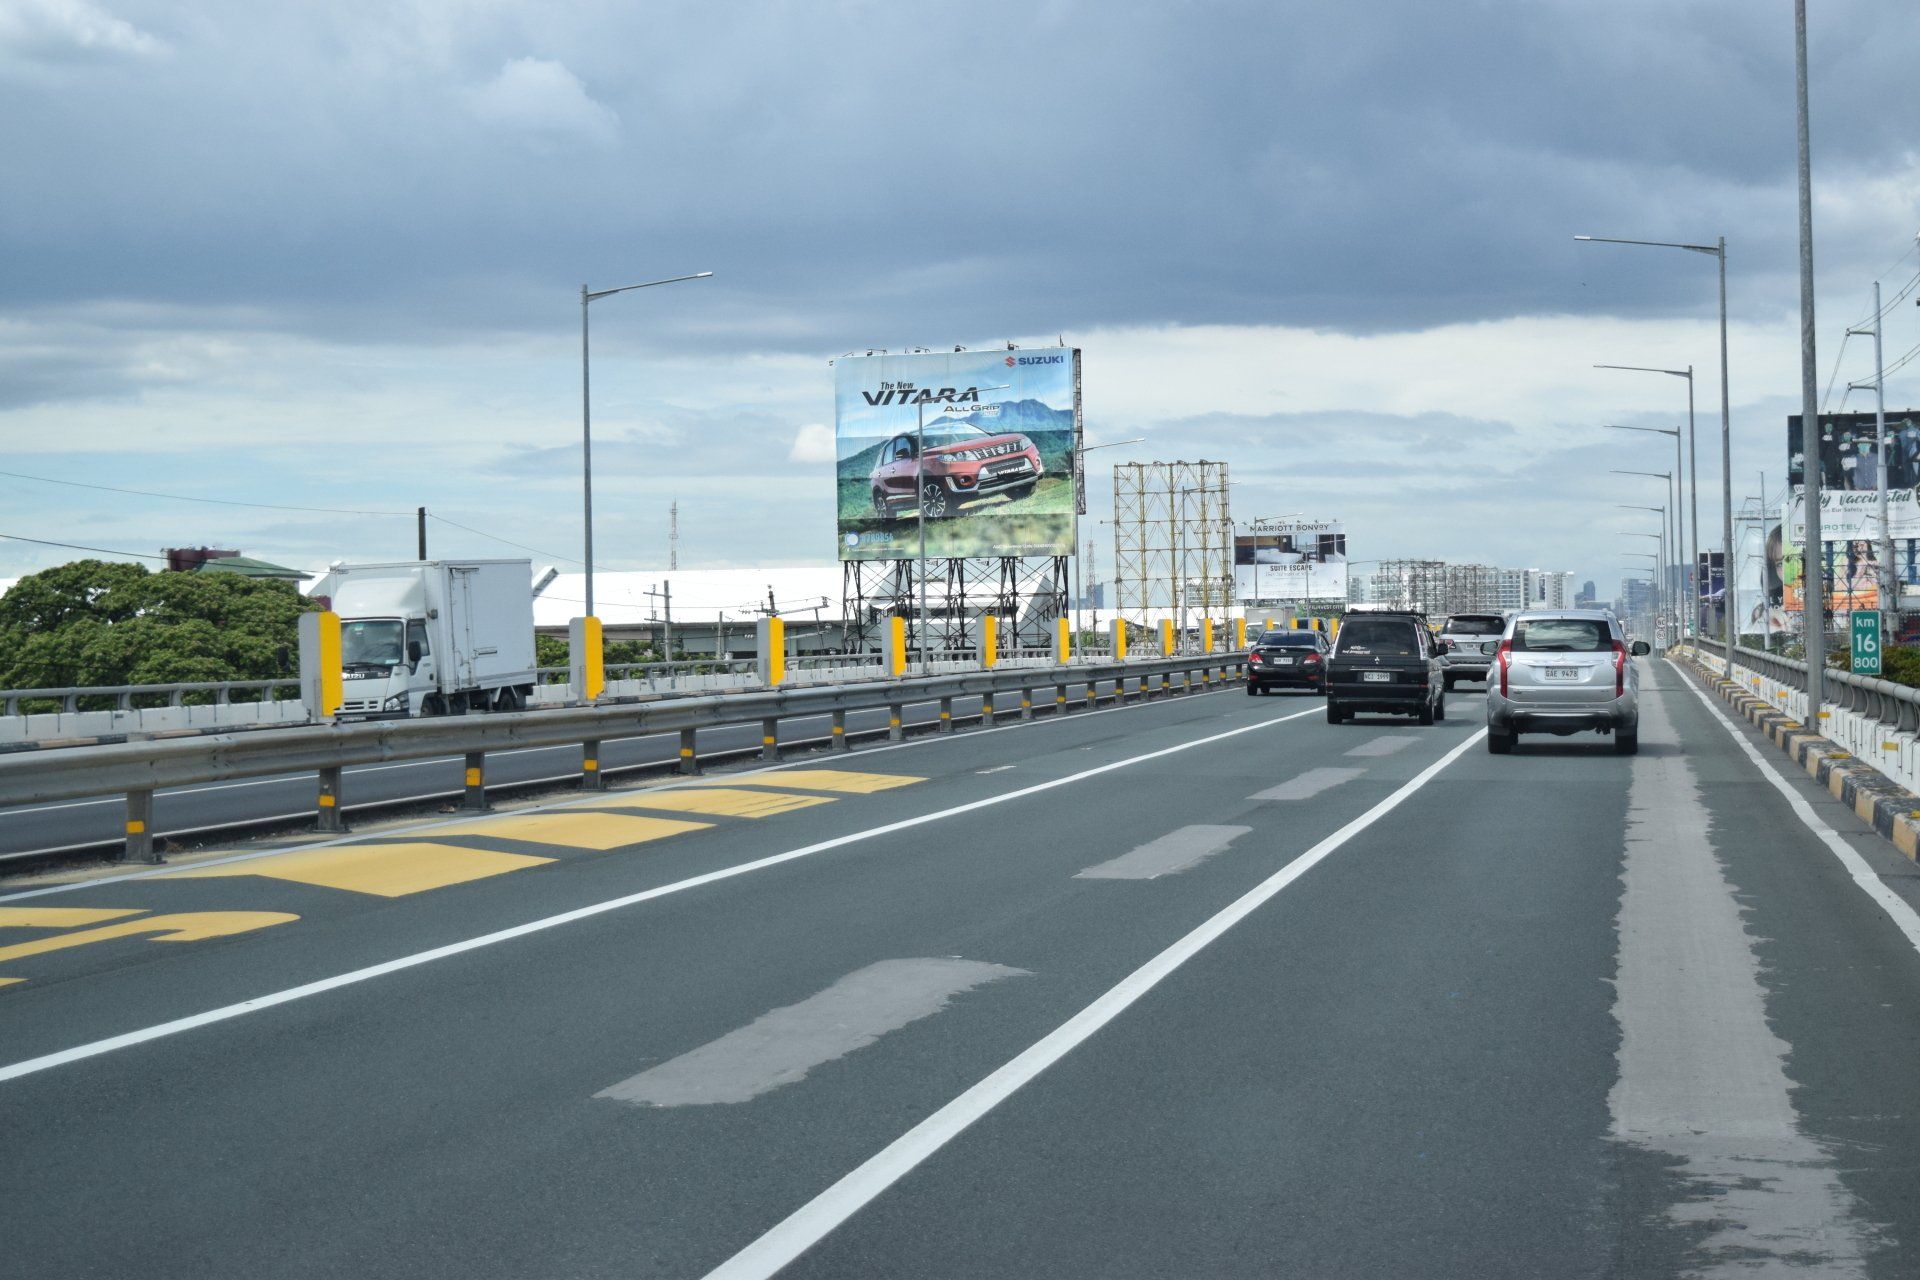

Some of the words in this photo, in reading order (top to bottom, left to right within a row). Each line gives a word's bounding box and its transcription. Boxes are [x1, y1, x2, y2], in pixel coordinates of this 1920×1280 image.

[1018, 356, 1064, 365] SUZUKI
[880, 382, 894, 390] The
[897, 381, 914, 389] New
[862, 386, 979, 406] VITARA
[1839, 490, 1911, 506] Vaccinted
[1856, 616, 1875, 628] km
[1855, 633, 1876, 652] 16
[1854, 657, 1878, 668] 800
[1545, 669, 1558, 678] GAE
[1561, 669, 1578, 678] 9478
